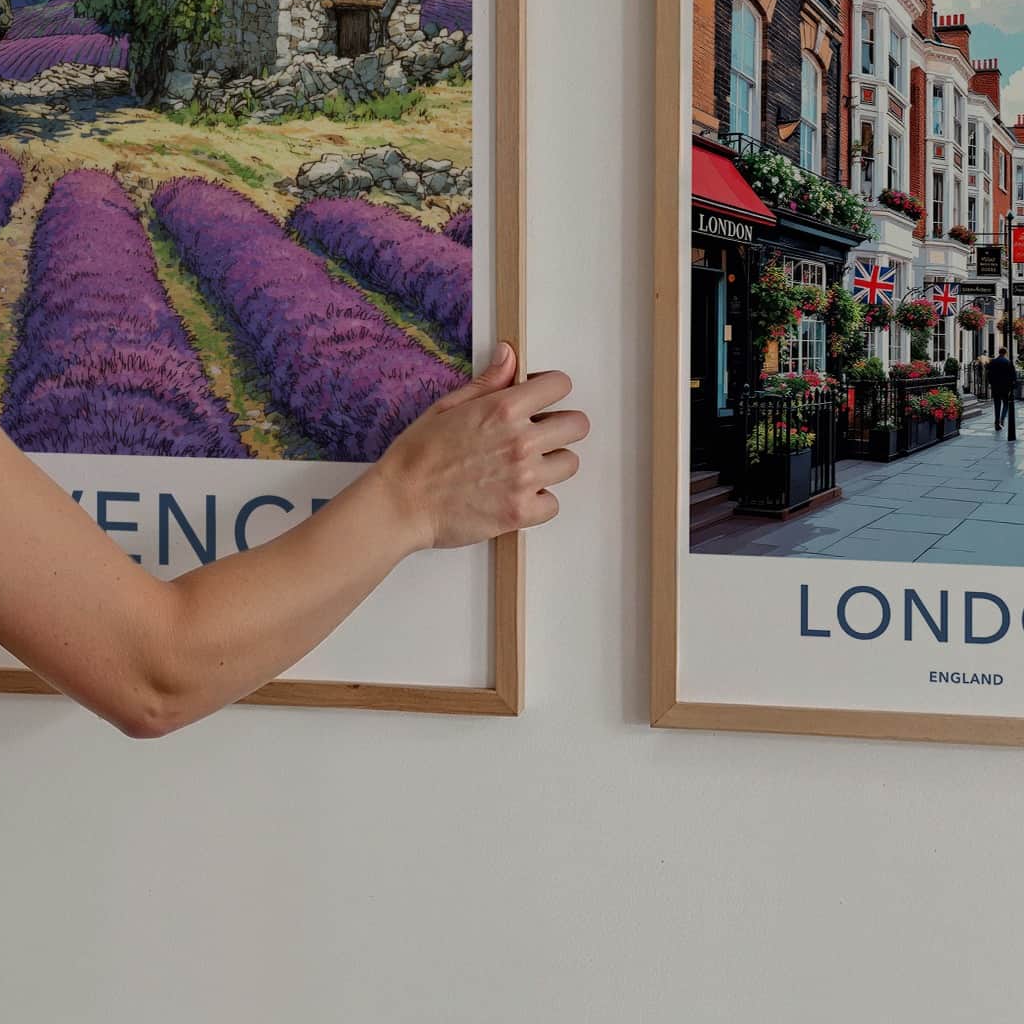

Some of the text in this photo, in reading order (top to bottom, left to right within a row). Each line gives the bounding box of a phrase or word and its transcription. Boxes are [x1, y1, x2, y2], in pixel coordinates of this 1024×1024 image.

[698, 213, 753, 242] LONDON
[800, 584, 1024, 645] LOND
[929, 671, 1004, 686] ENGLAND
